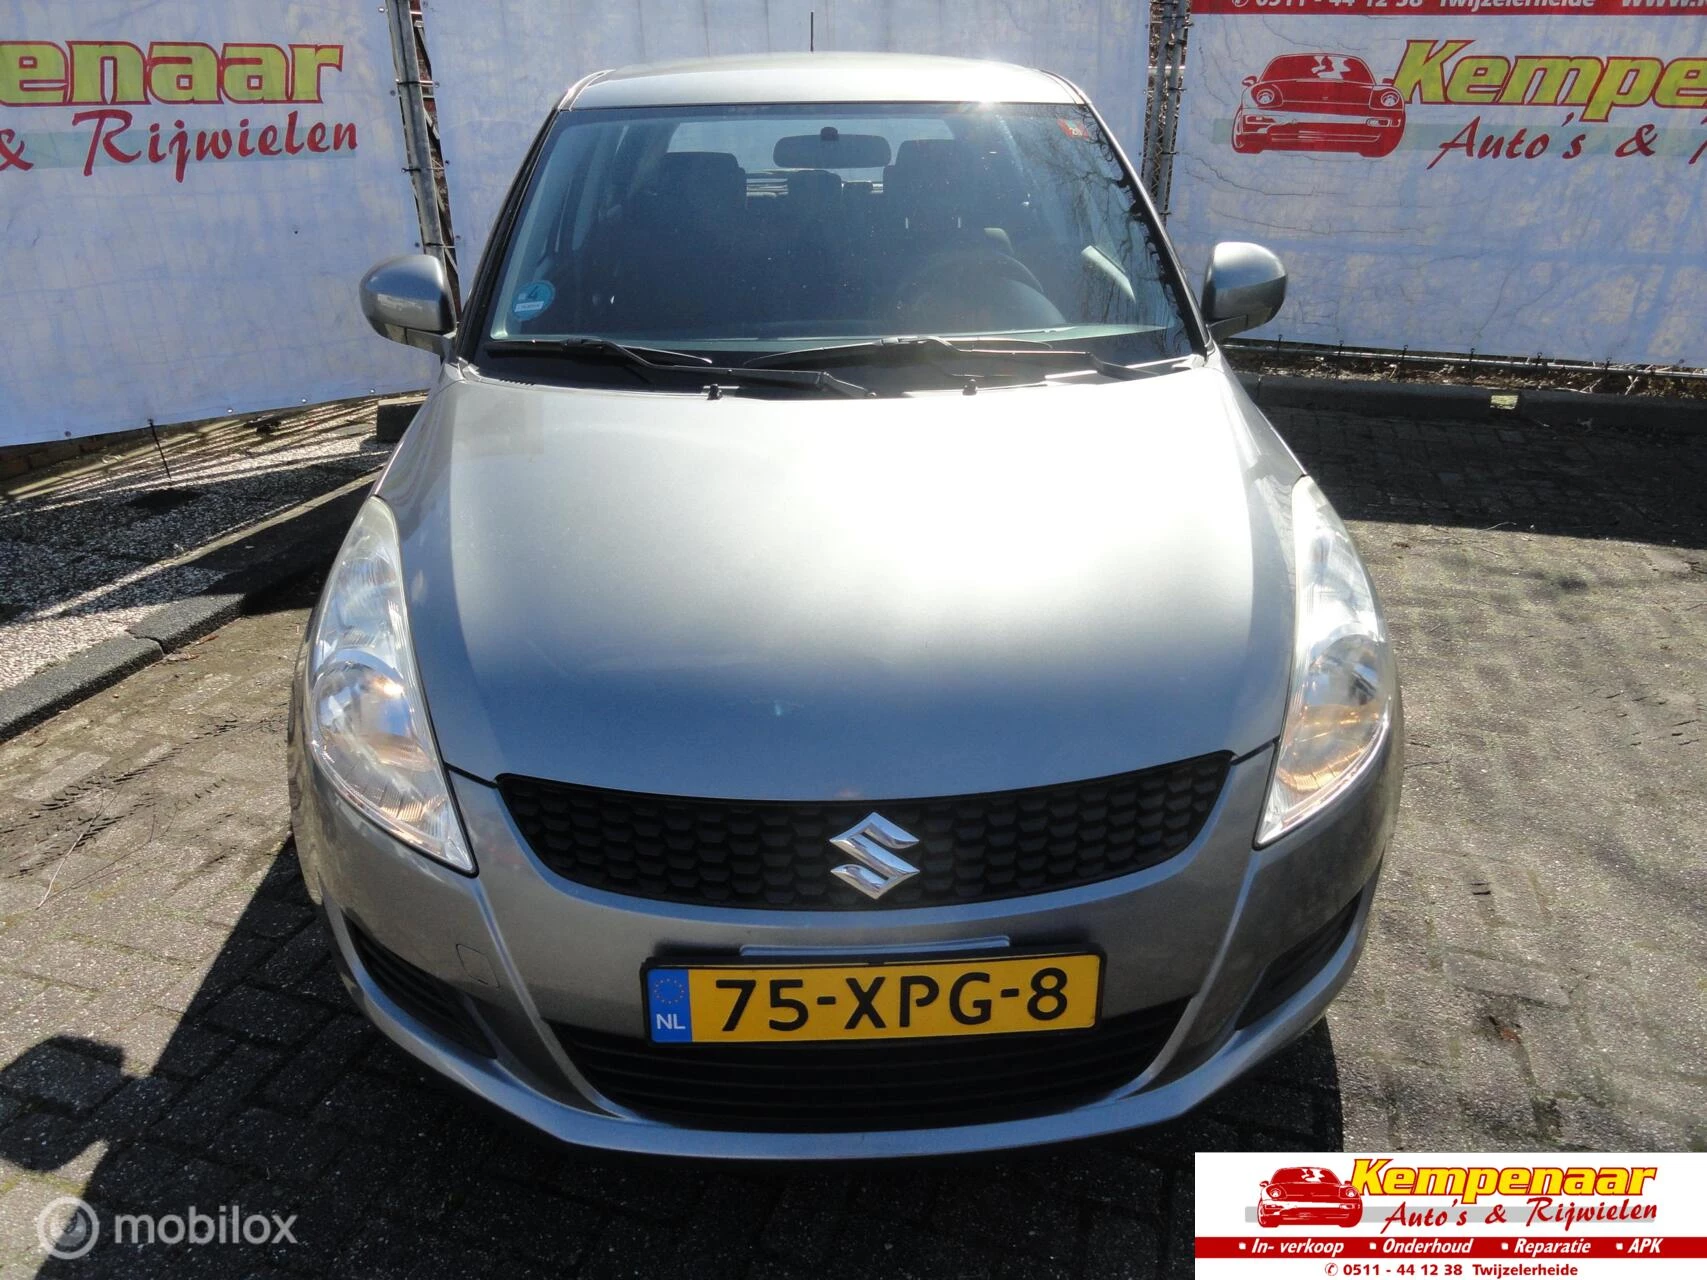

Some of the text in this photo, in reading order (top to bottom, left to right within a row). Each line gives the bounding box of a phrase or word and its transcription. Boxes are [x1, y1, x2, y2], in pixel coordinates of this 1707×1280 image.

[72, 109, 359, 184] Rijwielen
[1426, 115, 1587, 170] Auto's
[1614, 123, 1659, 158] &
[656, 1014, 686, 1030] NL
[715, 967, 1068, 1032] 75-XPG-8
